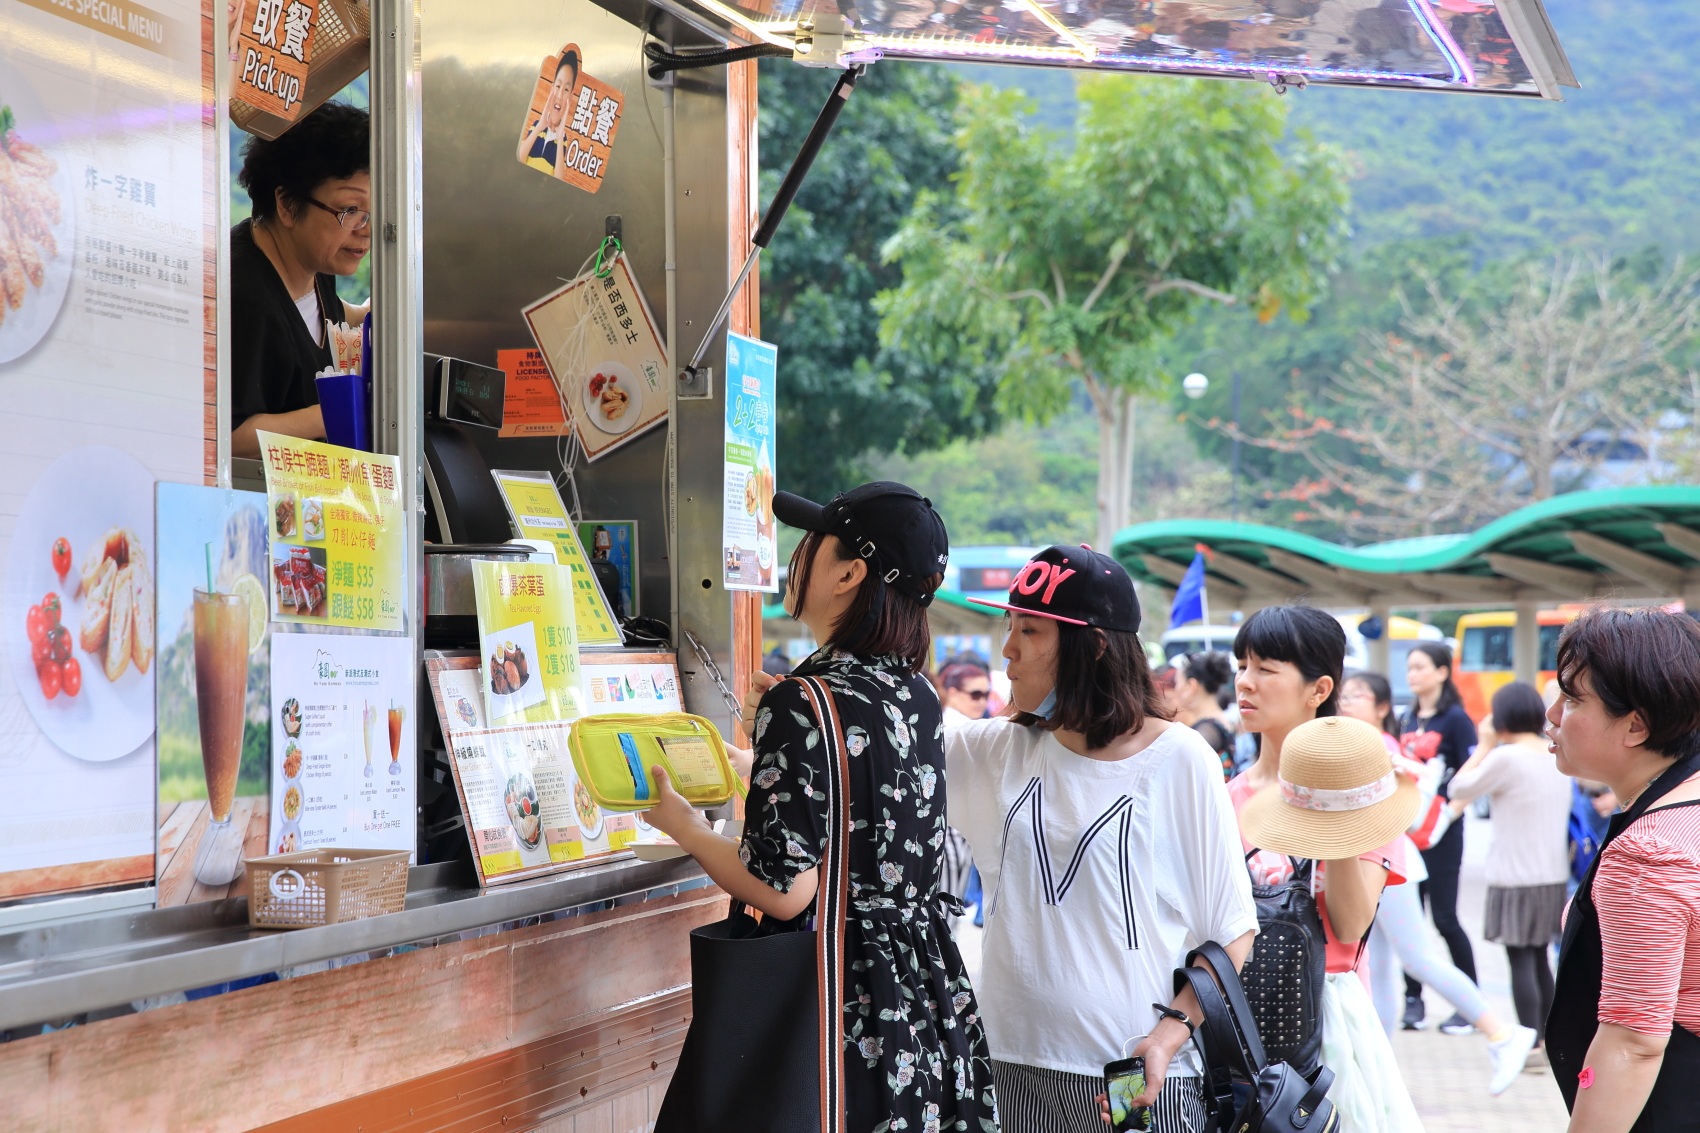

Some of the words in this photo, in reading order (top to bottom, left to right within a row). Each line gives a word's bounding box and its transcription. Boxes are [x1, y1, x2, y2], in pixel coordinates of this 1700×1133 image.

[75, 0, 126, 30] SPECIAL
[128, 12, 163, 44] MENU
[252, 0, 313, 62] 取餐
[242, 49, 277, 94] Pick
[278, 73, 299, 110] up
[570, 84, 619, 147] 點餐
[566, 139, 603, 178] Order
[604, 276, 639, 345] 是否西多士
[305, 482, 313, 492] Fish
[331, 527, 376, 551] 刀削公仔麵
[332, 560, 354, 587] 淨麵
[357, 562, 374, 589] $35
[357, 595, 374, 621] $58
[557, 625, 572, 648] $10
[560, 653, 575, 674] $18
[373, 809, 390, 820] 買一送一
[391, 819, 400, 828] FREE
